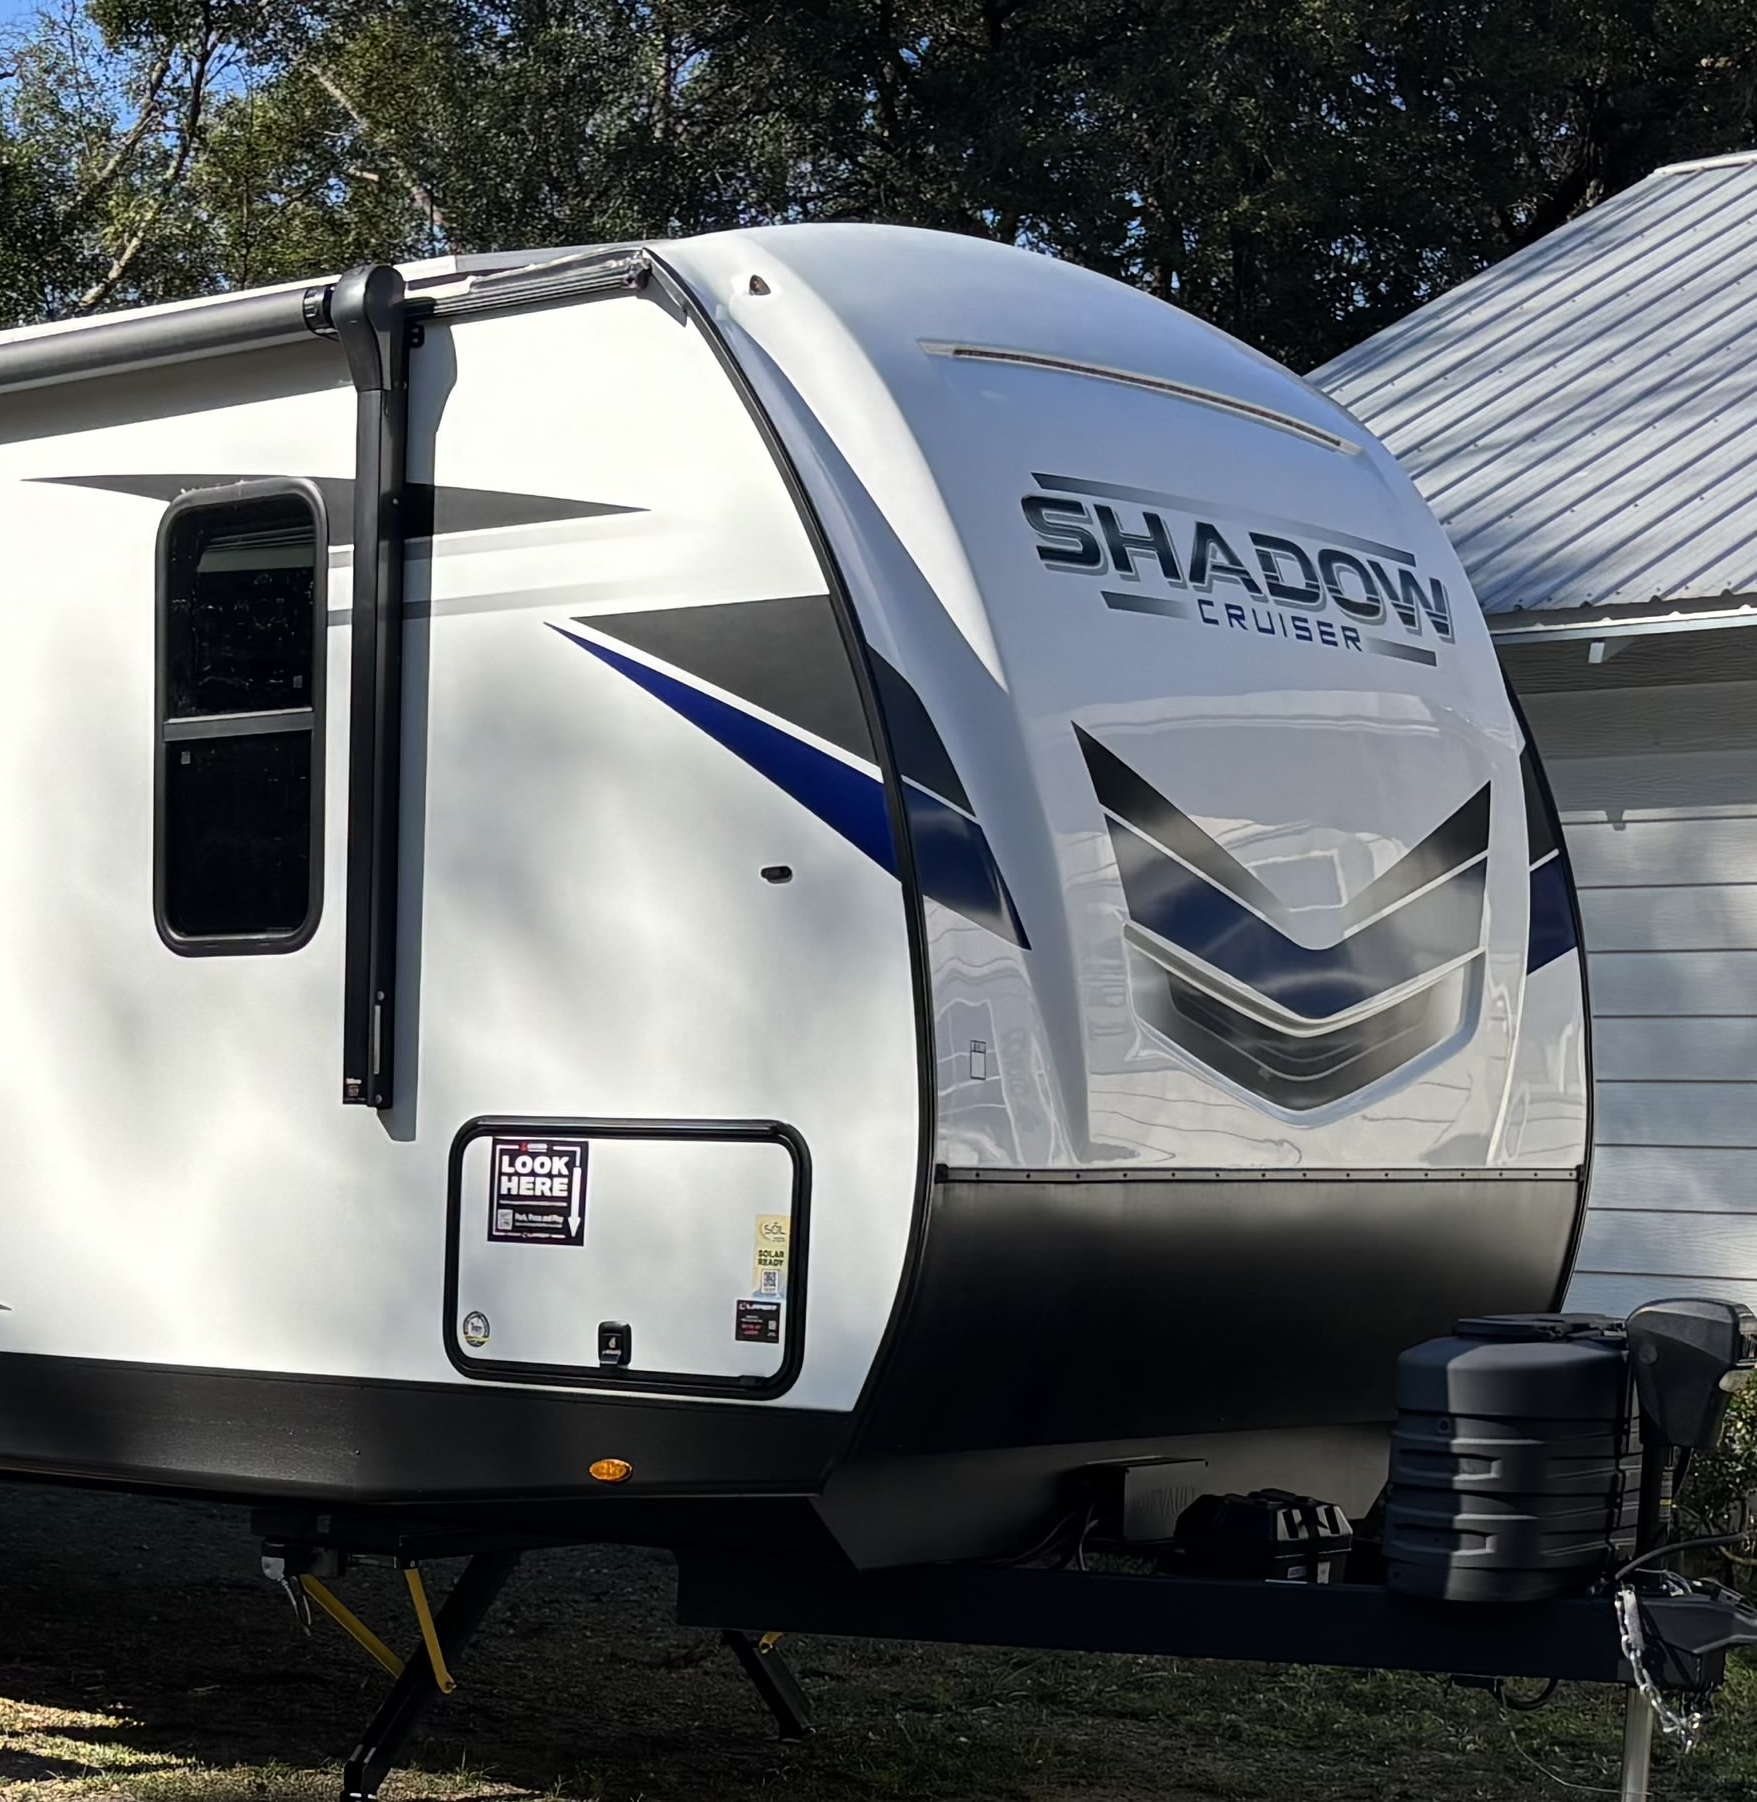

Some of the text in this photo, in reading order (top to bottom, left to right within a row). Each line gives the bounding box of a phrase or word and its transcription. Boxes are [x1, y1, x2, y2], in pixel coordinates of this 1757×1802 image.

[1021, 495, 1455, 642] SHADOW
[1199, 600, 1364, 653] CRUISER
[501, 1154, 570, 1175] LOOK
[500, 1175, 569, 1197] HERE
[757, 1258, 784, 1267] READY
[758, 1249, 785, 1258] SOLAR
